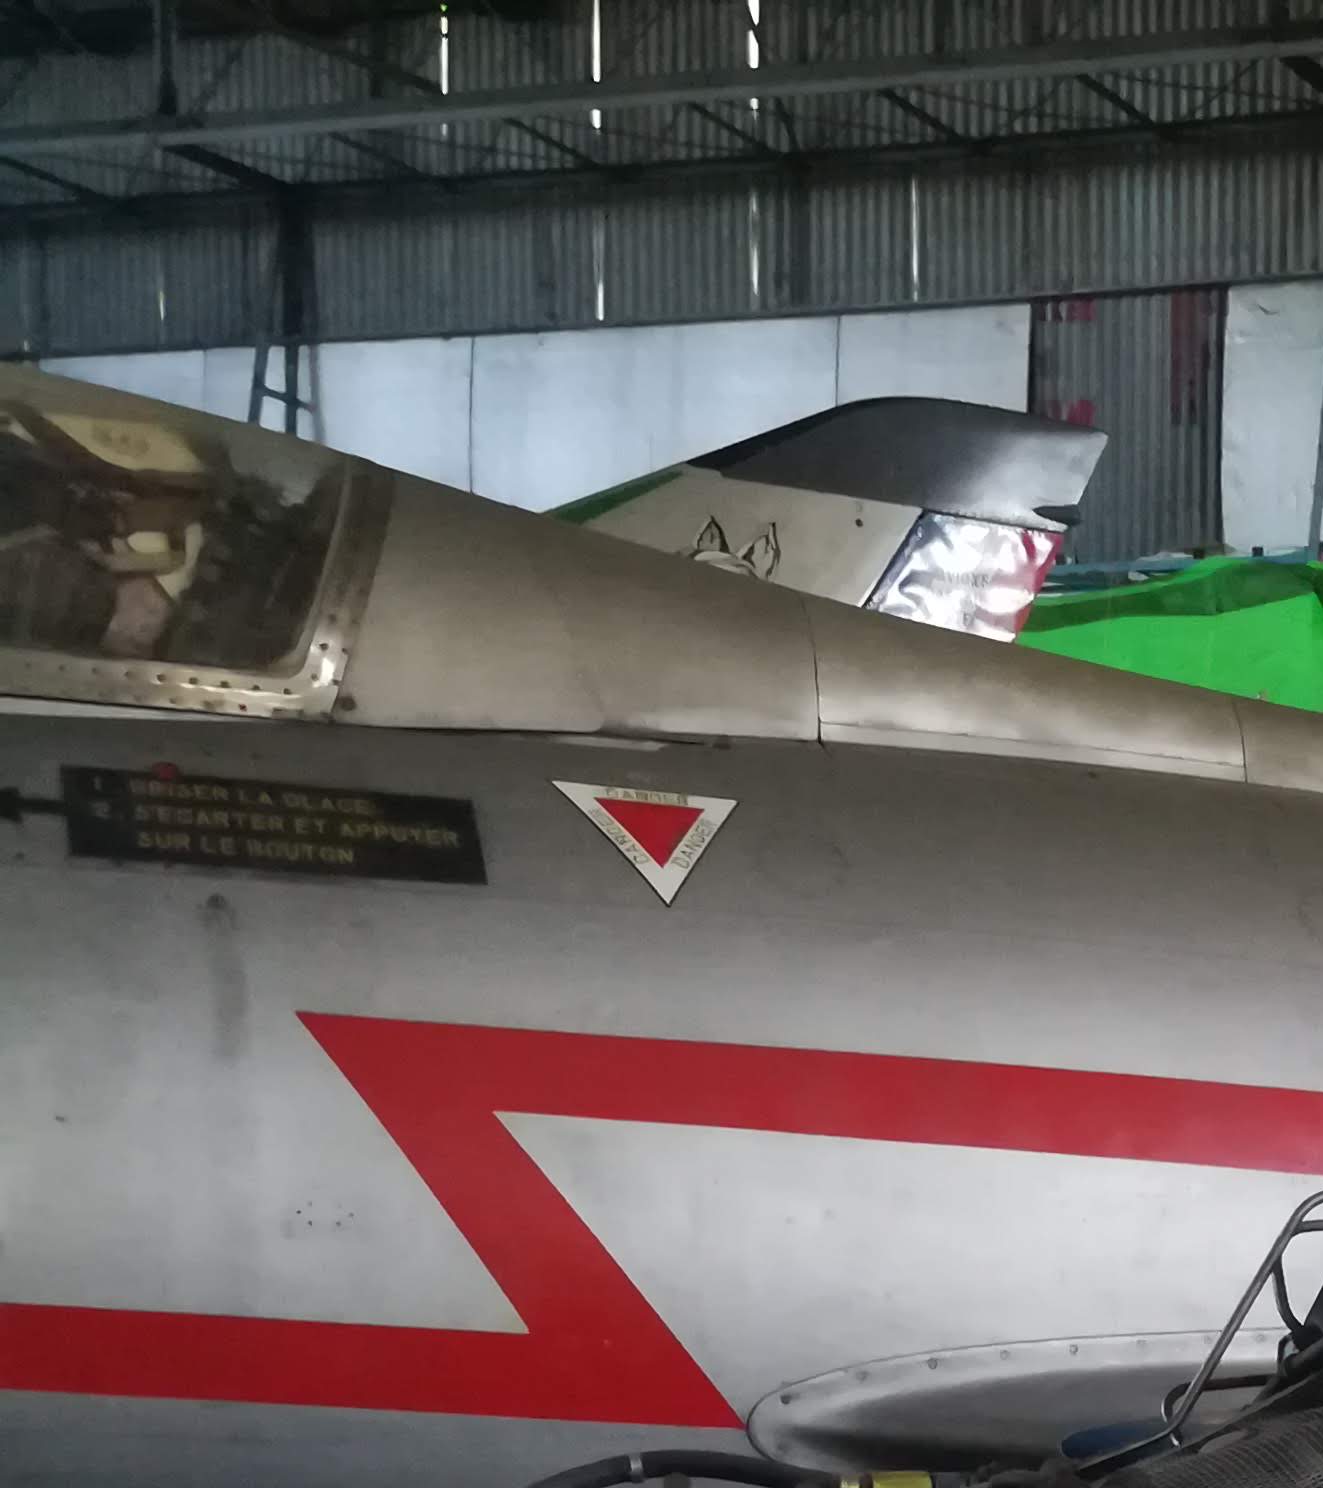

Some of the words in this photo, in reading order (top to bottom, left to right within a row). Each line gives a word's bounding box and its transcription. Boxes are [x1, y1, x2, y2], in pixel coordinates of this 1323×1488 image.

[238, 786, 272, 806] LA
[138, 831, 190, 851] SUR
[201, 836, 237, 856] LE
[247, 839, 355, 865] BOUTON
[295, 817, 327, 835] ET
[340, 822, 459, 847] APPUYER
[671, 819, 715, 869] DANGER
